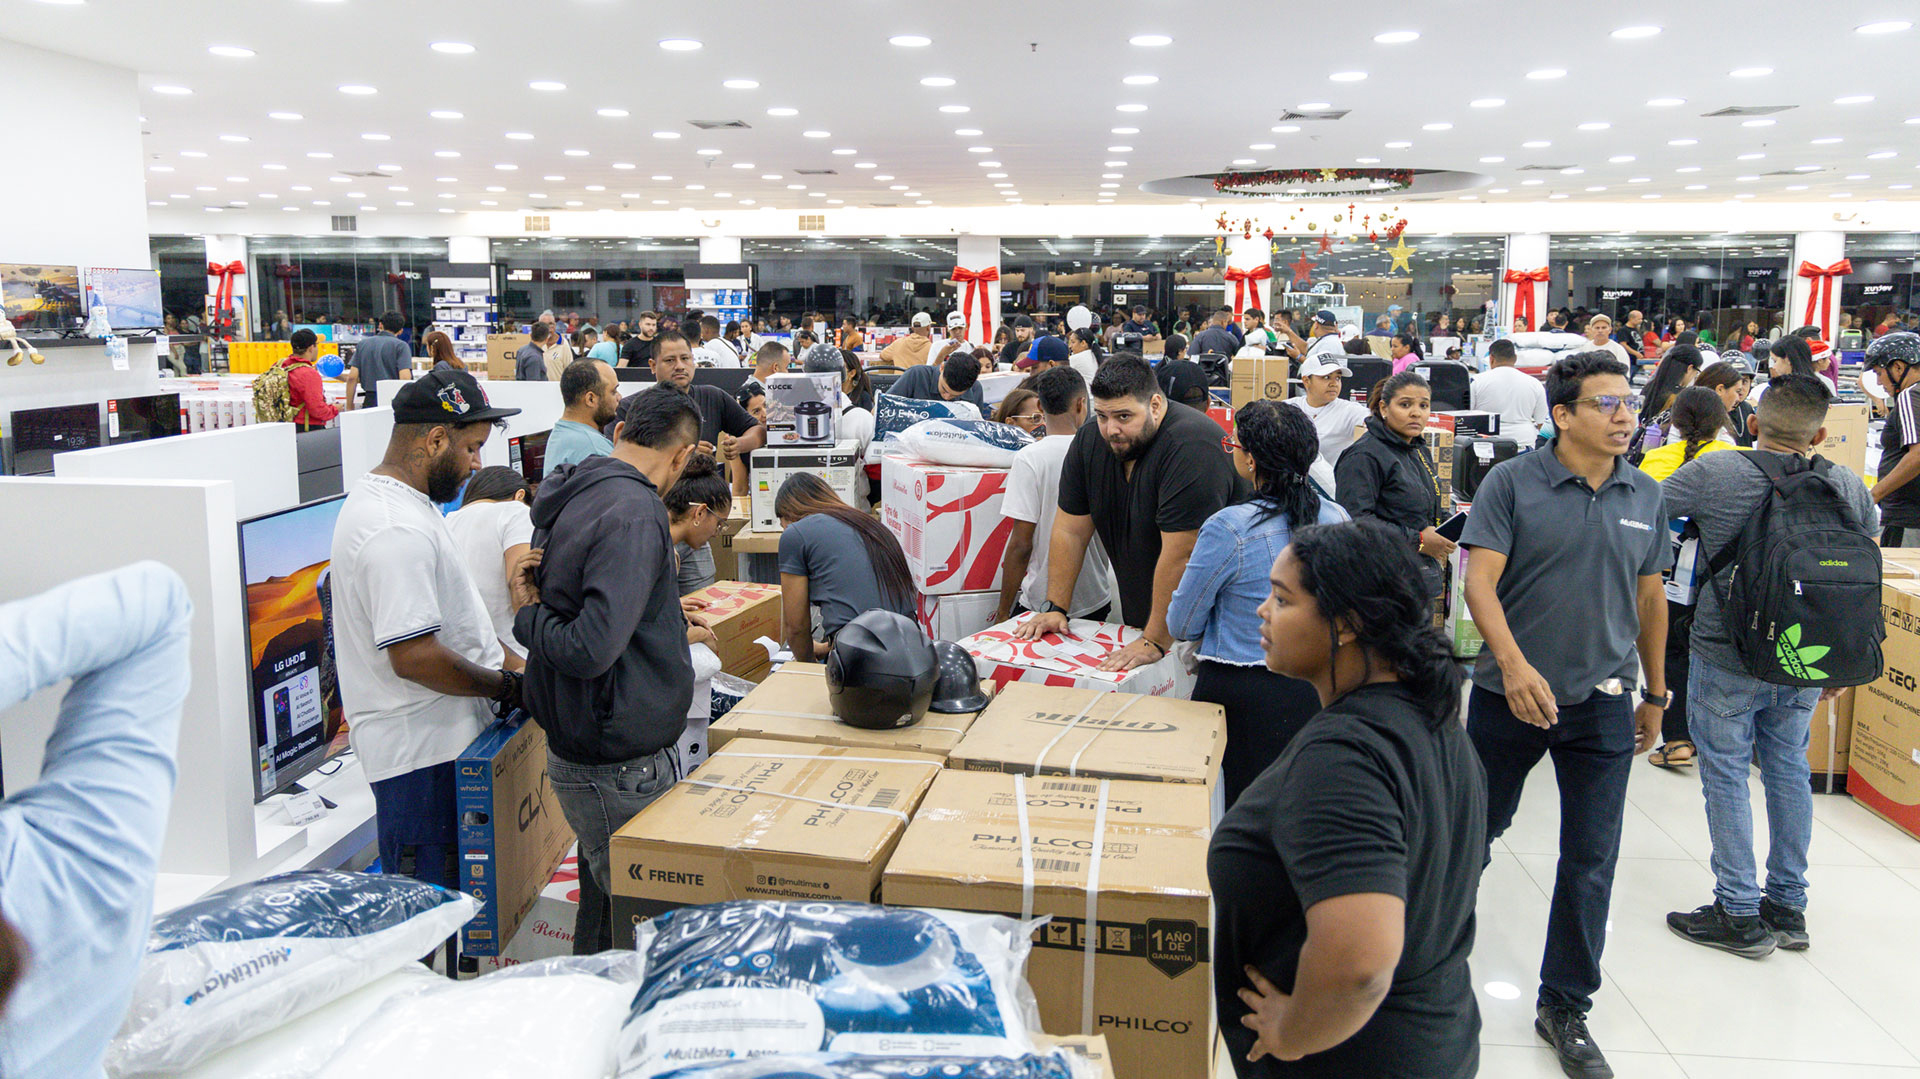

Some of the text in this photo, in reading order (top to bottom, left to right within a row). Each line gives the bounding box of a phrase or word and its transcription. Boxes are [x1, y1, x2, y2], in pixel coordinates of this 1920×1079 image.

[503, 351, 517, 360] CL
[879, 408, 930, 419] SUEÑO
[1819, 559, 1849, 567] adidas
[274, 660, 285, 673] LG
[285, 654, 300, 668] UHD
[1782, 643, 1804, 675] adidas
[1868, 685, 1894, 703] WASHING
[281, 747, 298, 761] Magic
[298, 735, 318, 751] Remote
[461, 765, 485, 780] CLX
[518, 769, 550, 833] CLX
[804, 781, 854, 827] PHICO
[972, 833, 1093, 849] PHLCO
[649, 869, 704, 887] FRENTE
[778, 877, 822, 889] @multimax
[1151, 929, 1192, 951] 1 AÑO
[1169, 942, 1185, 952] DE
[1151, 952, 1193, 963] GARANTÍA
[1099, 1015, 1189, 1035] PHILCO
[668, 1046, 730, 1060] MultiMax
